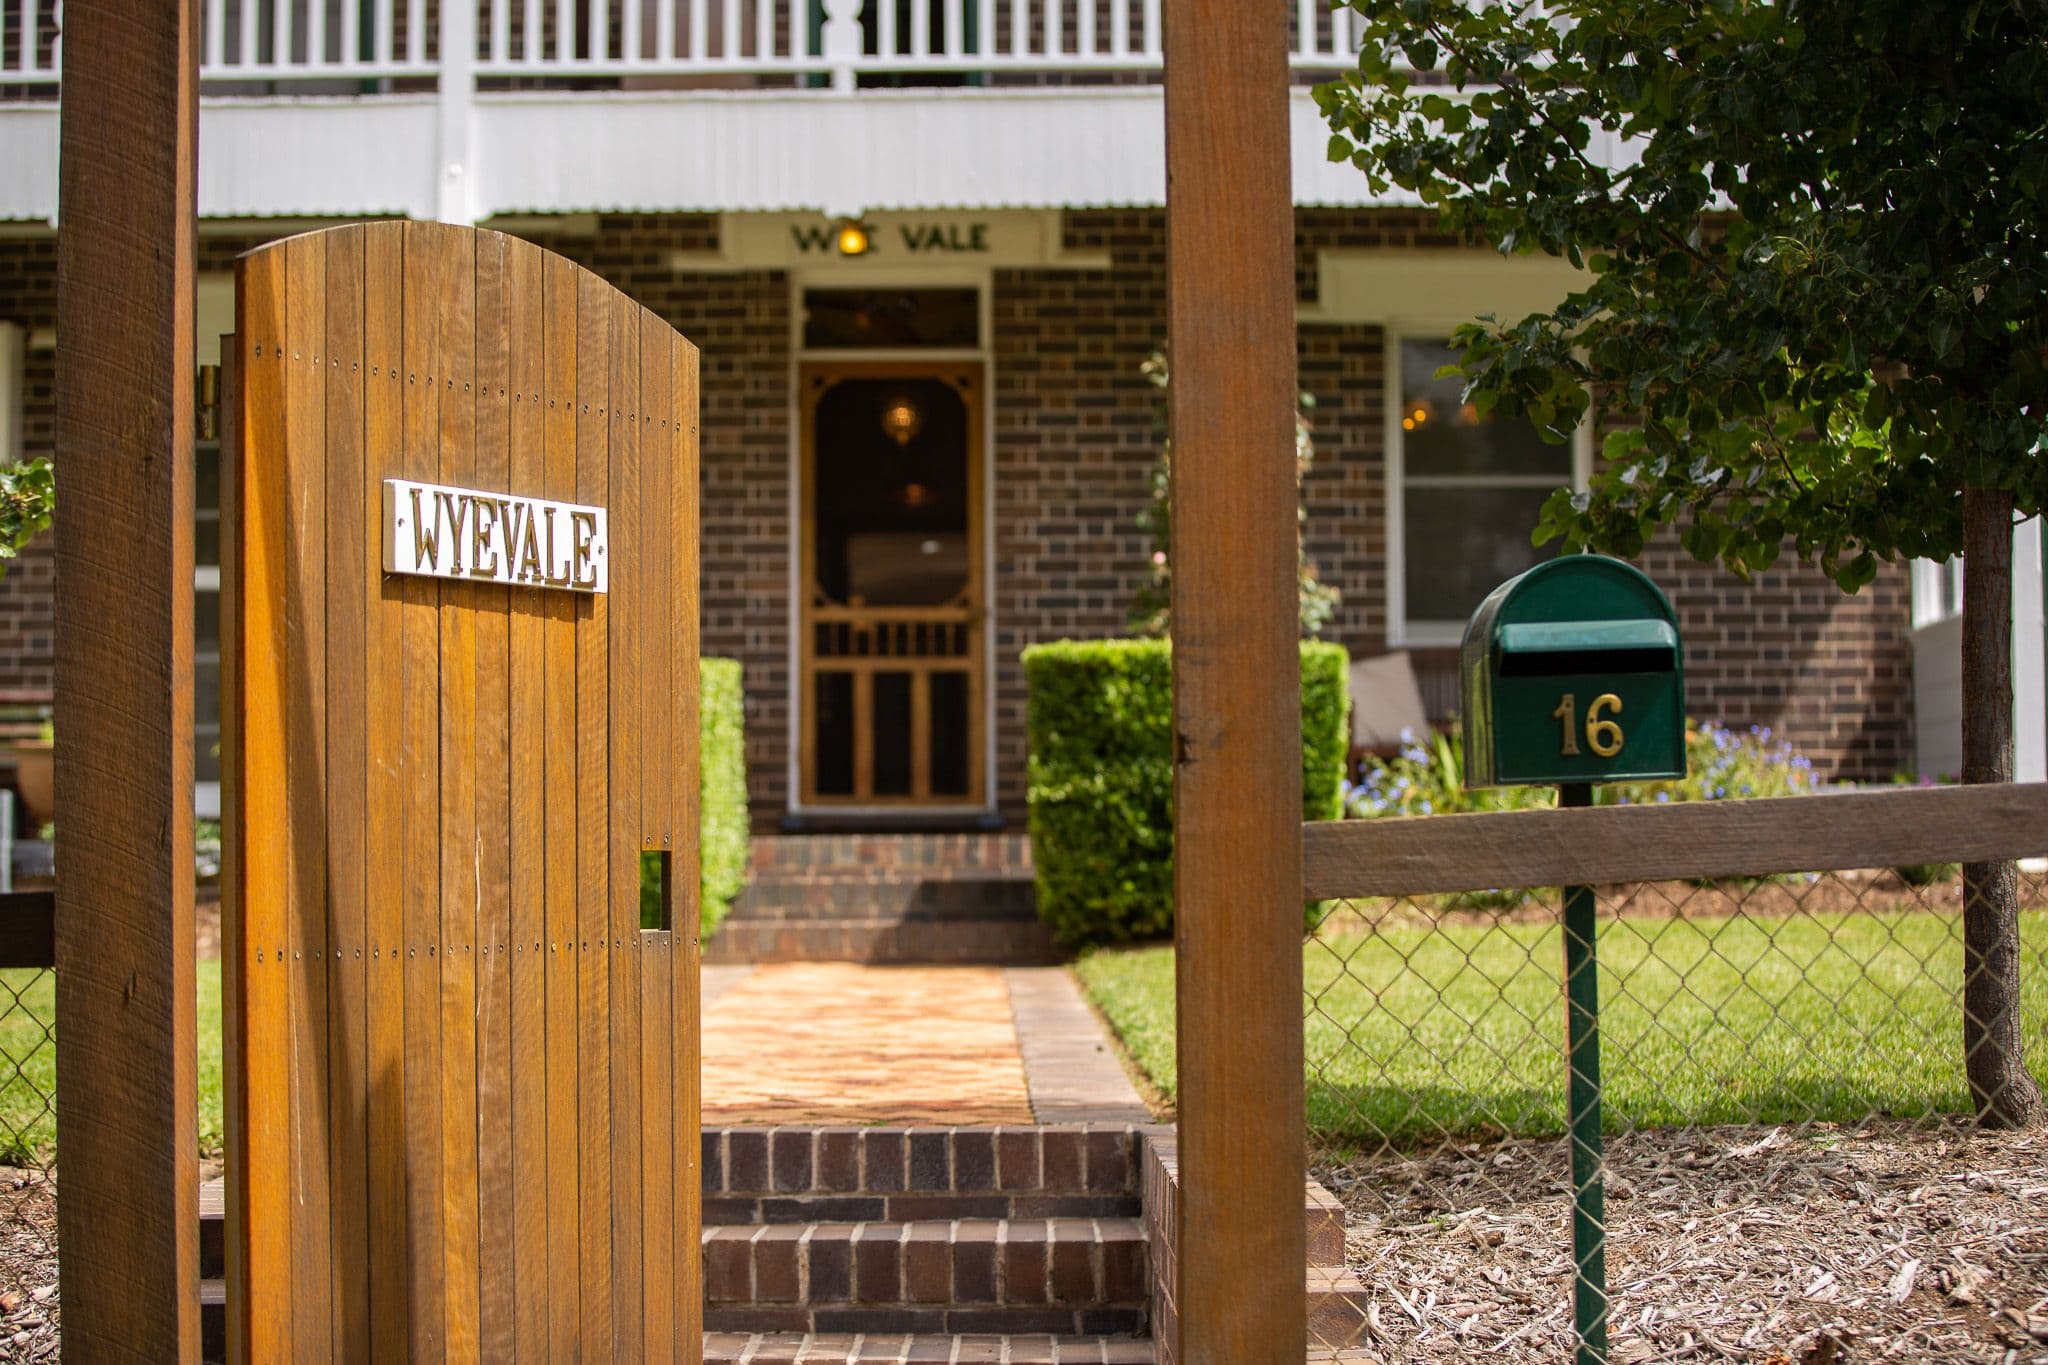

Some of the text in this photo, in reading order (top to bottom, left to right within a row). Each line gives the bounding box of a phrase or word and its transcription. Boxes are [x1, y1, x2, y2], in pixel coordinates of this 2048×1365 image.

[791, 223, 988, 252] WE VALE
[409, 487, 598, 589] WYEVALE
[1553, 693, 1624, 757] 16
